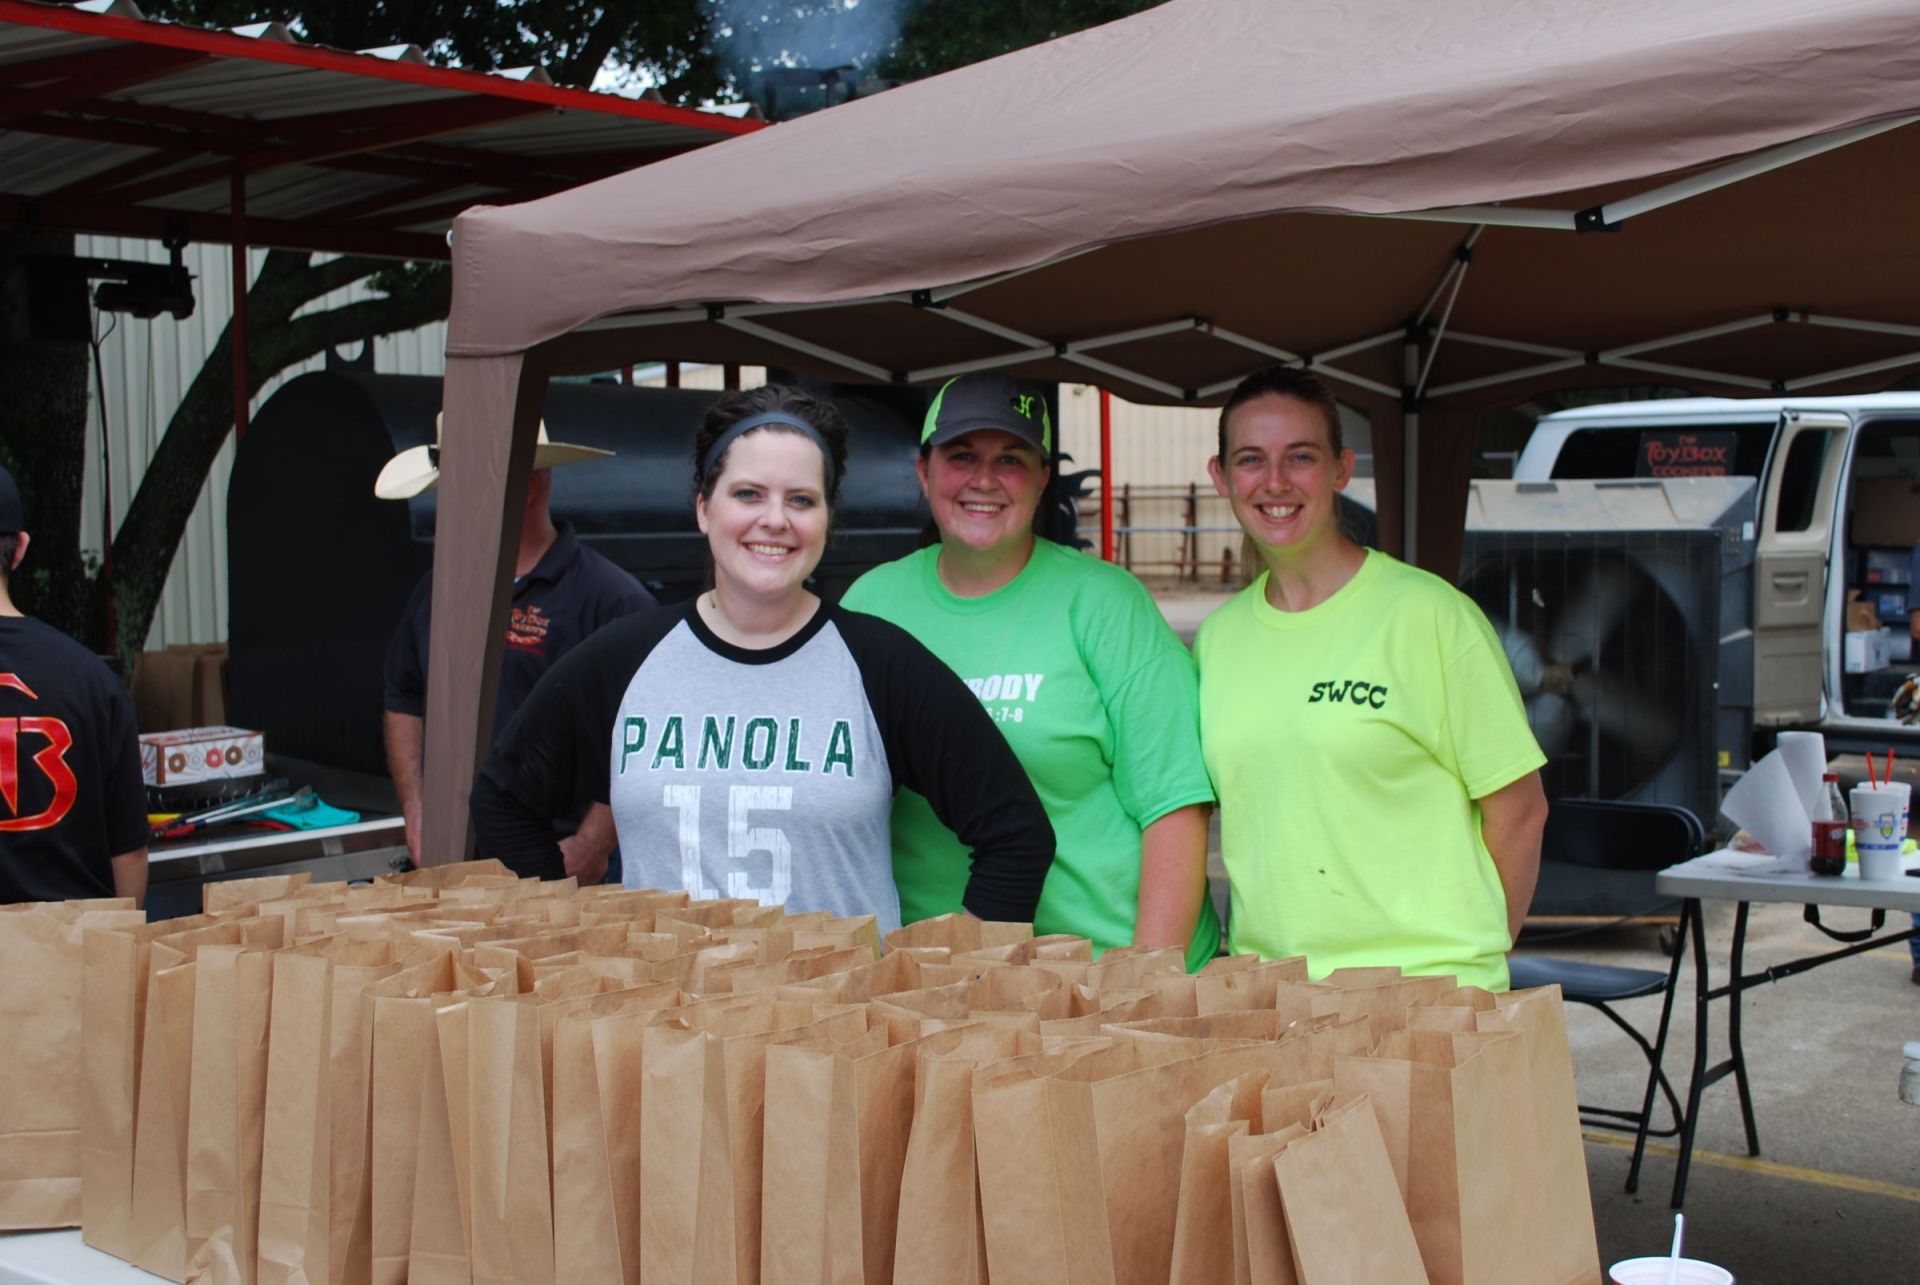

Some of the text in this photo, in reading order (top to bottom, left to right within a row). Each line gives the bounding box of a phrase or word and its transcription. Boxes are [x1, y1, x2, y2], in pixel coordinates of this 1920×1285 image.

[963, 673, 1044, 702] BODY
[1308, 680, 1388, 709] SWCC
[619, 715, 856, 778] PANOLA
[663, 784, 793, 907] 15
